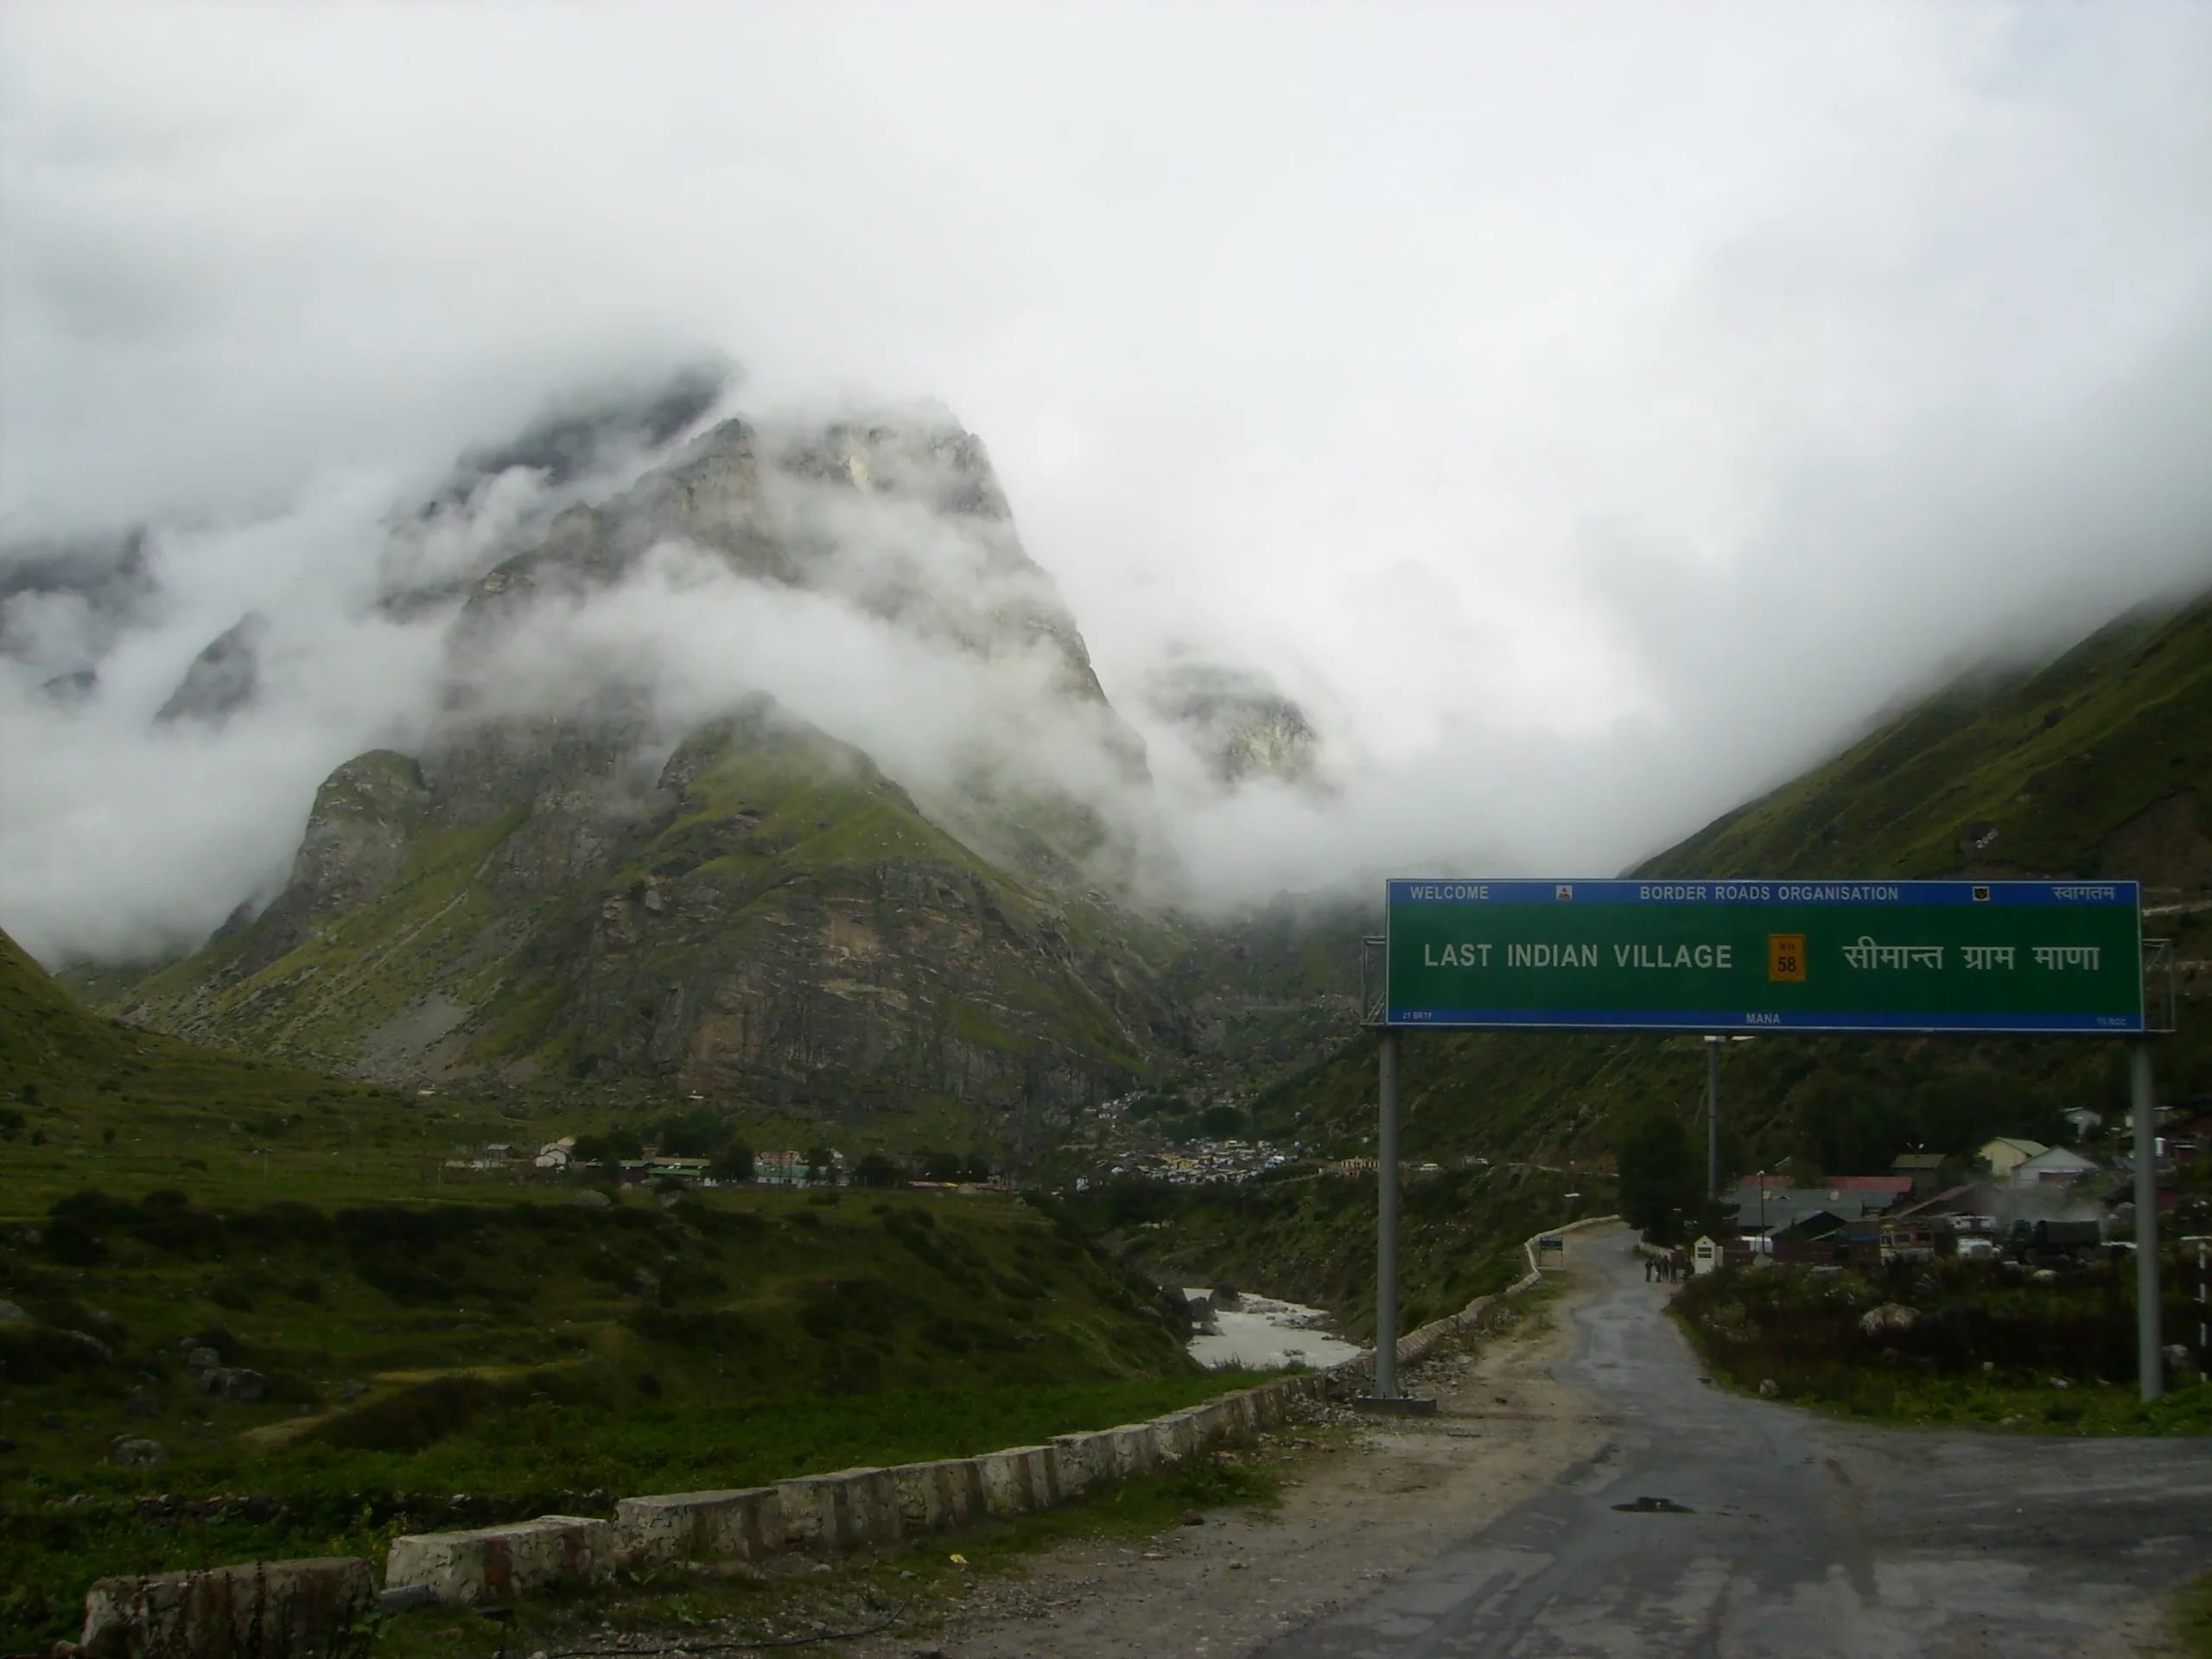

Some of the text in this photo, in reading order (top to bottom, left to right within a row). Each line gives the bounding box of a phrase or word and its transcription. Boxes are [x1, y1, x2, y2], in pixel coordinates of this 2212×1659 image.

[1410, 886, 1489, 899] WELCOME
[1641, 887, 1898, 900] BORDER ROADS ORGANISATION
[1424, 944, 1732, 969] LAST INDIAN VILLAGE
[1842, 936, 2101, 970] सीमान्त ग्राम माणा
[1777, 956, 1797, 973] 58
[1745, 1013, 1781, 1025] MANA
